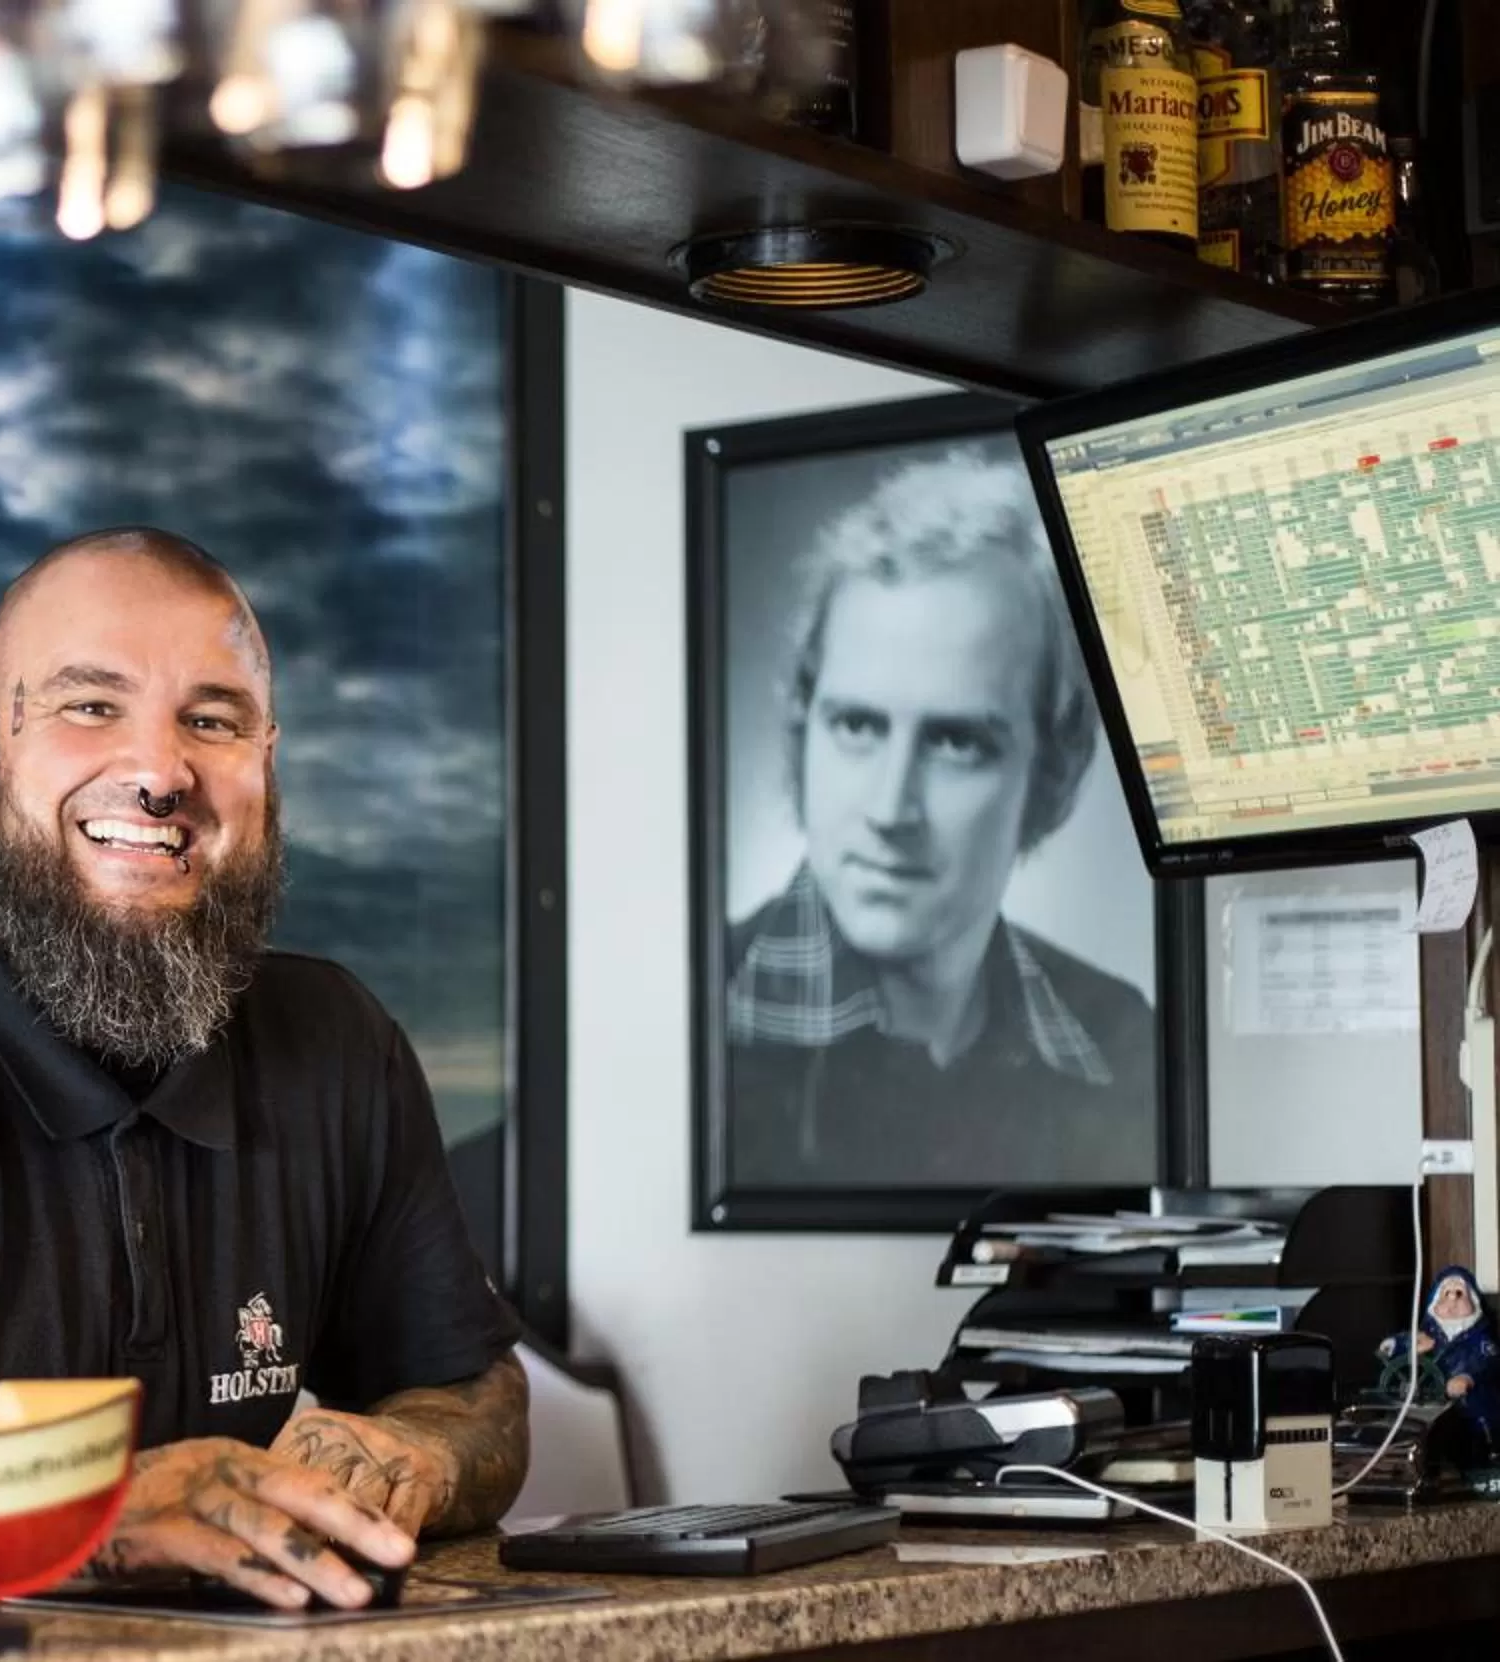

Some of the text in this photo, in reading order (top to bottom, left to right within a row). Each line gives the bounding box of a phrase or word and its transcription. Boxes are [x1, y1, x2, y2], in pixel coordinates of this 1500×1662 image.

[1296, 111, 1387, 154] JIM BEAM
[1299, 187, 1382, 223] Honey
[209, 1363, 300, 1405] HOLSTEN
